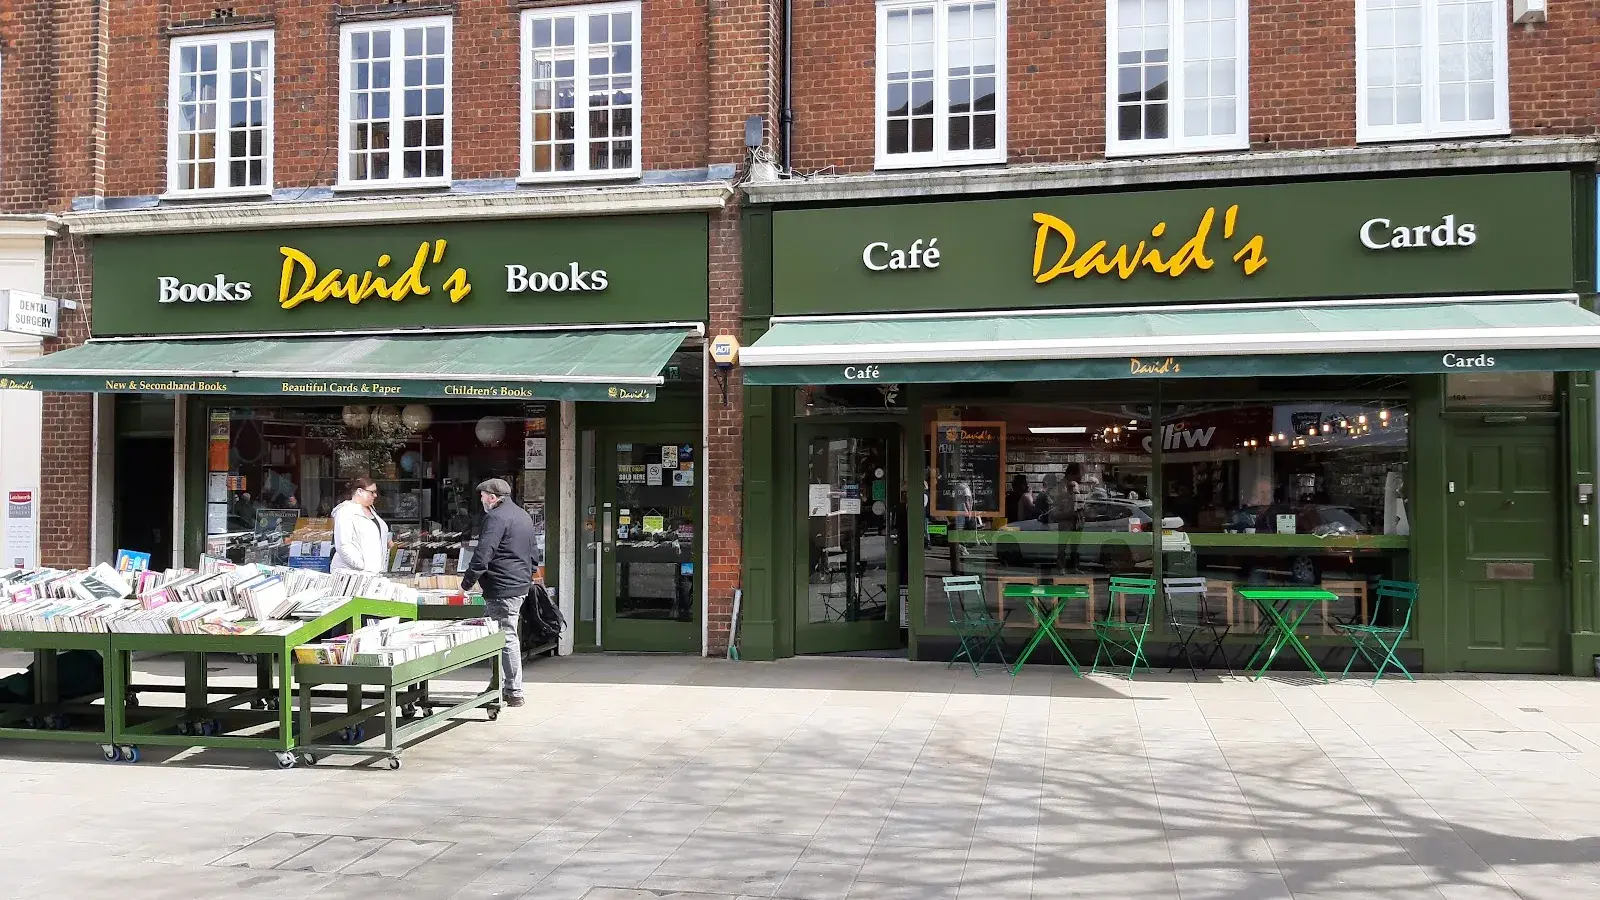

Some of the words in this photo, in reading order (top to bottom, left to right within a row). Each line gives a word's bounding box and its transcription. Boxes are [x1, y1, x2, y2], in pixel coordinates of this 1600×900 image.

[1359, 214, 1477, 251] Cards
[1032, 204, 1268, 284] David's
[862, 238, 940, 272] Café
[279, 239, 472, 310] David's
[505, 261, 609, 294] Books
[157, 273, 252, 304] Books
[20, 300, 48, 314] DENTAL
[15, 313, 52, 329] SURGERY
[715, 344, 730, 354] ADT
[1130, 357, 1182, 375] David's
[1442, 353, 1496, 368] Cards
[844, 365, 880, 380] Café
[9, 380, 34, 390] David's
[105, 380, 127, 390] New
[129, 381, 137, 390] &
[139, 380, 196, 391] Secondhand
[197, 381, 227, 391] Books
[282, 380, 329, 393] Beautiful
[331, 382, 358, 393] Cards
[362, 383, 370, 393] &
[372, 383, 401, 396] Paper
[444, 384, 498, 397] Children's
[500, 385, 533, 397] Books
[620, 388, 650, 399] David's
[960, 430, 992, 439] David's
[939, 444, 956, 453] MENU
[619, 473, 632, 481] SOLD
[633, 473, 646, 481] HERE
